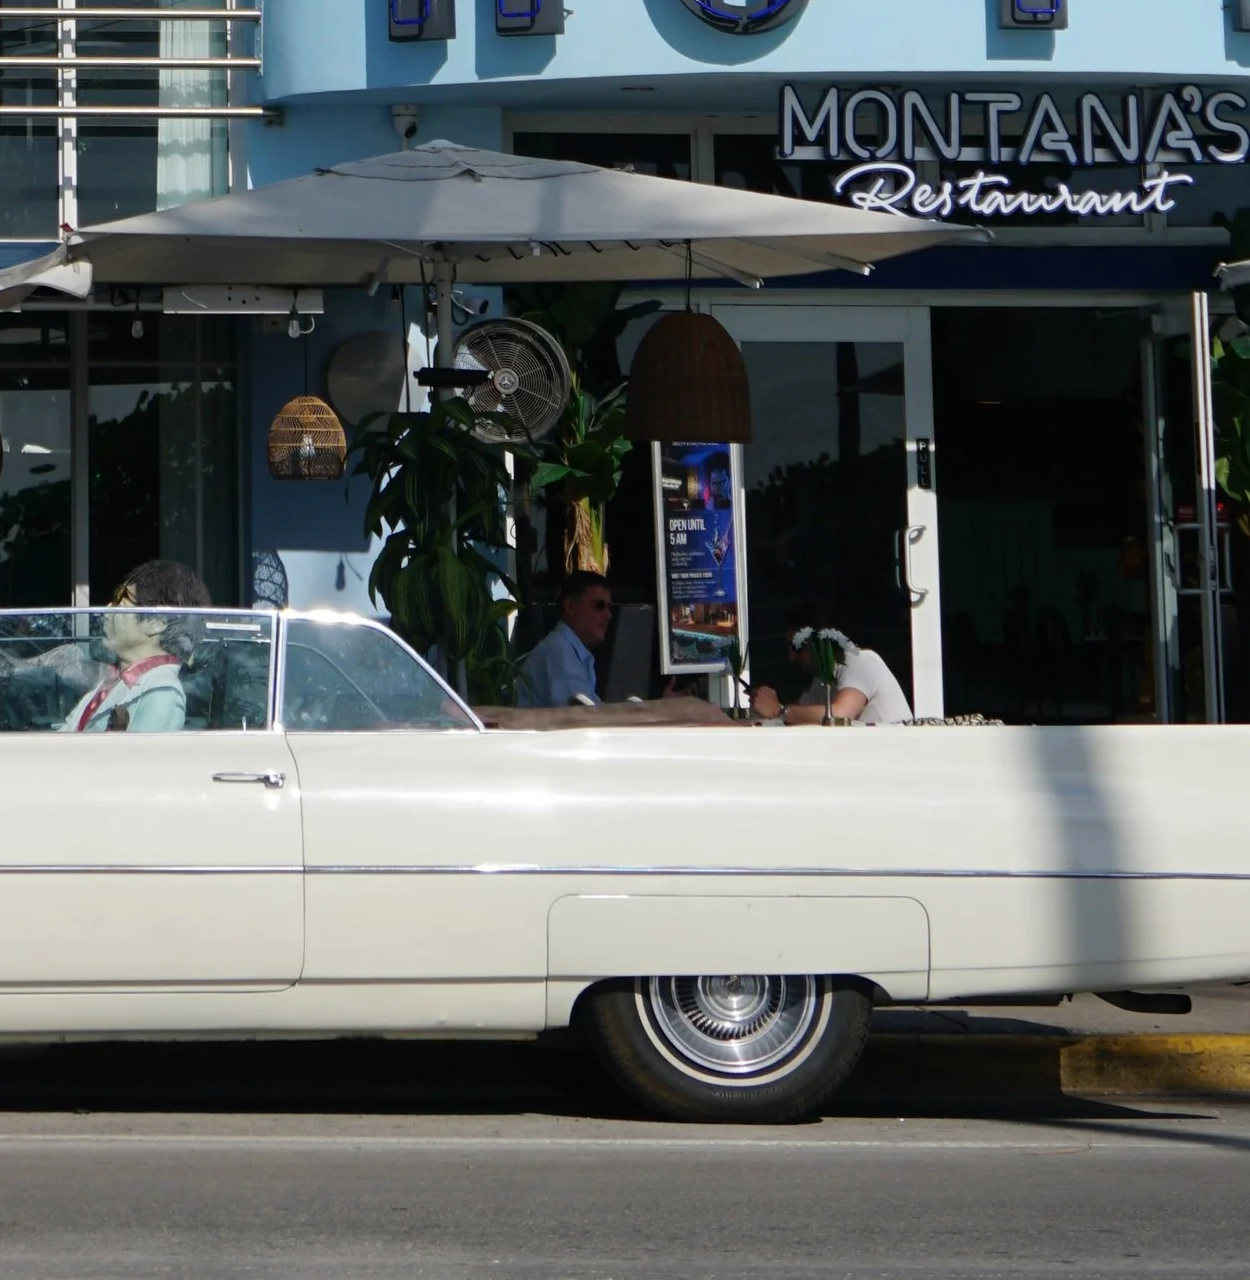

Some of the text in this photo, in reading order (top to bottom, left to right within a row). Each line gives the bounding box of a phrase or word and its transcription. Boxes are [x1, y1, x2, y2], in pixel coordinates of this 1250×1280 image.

[781, 83, 1250, 163] MONTANA'S
[835, 162, 1194, 223] Restaurant
[918, 441, 928, 486] PULL
[669, 519, 706, 532] OPEN UNTIL
[670, 533, 687, 545] 5 AM
